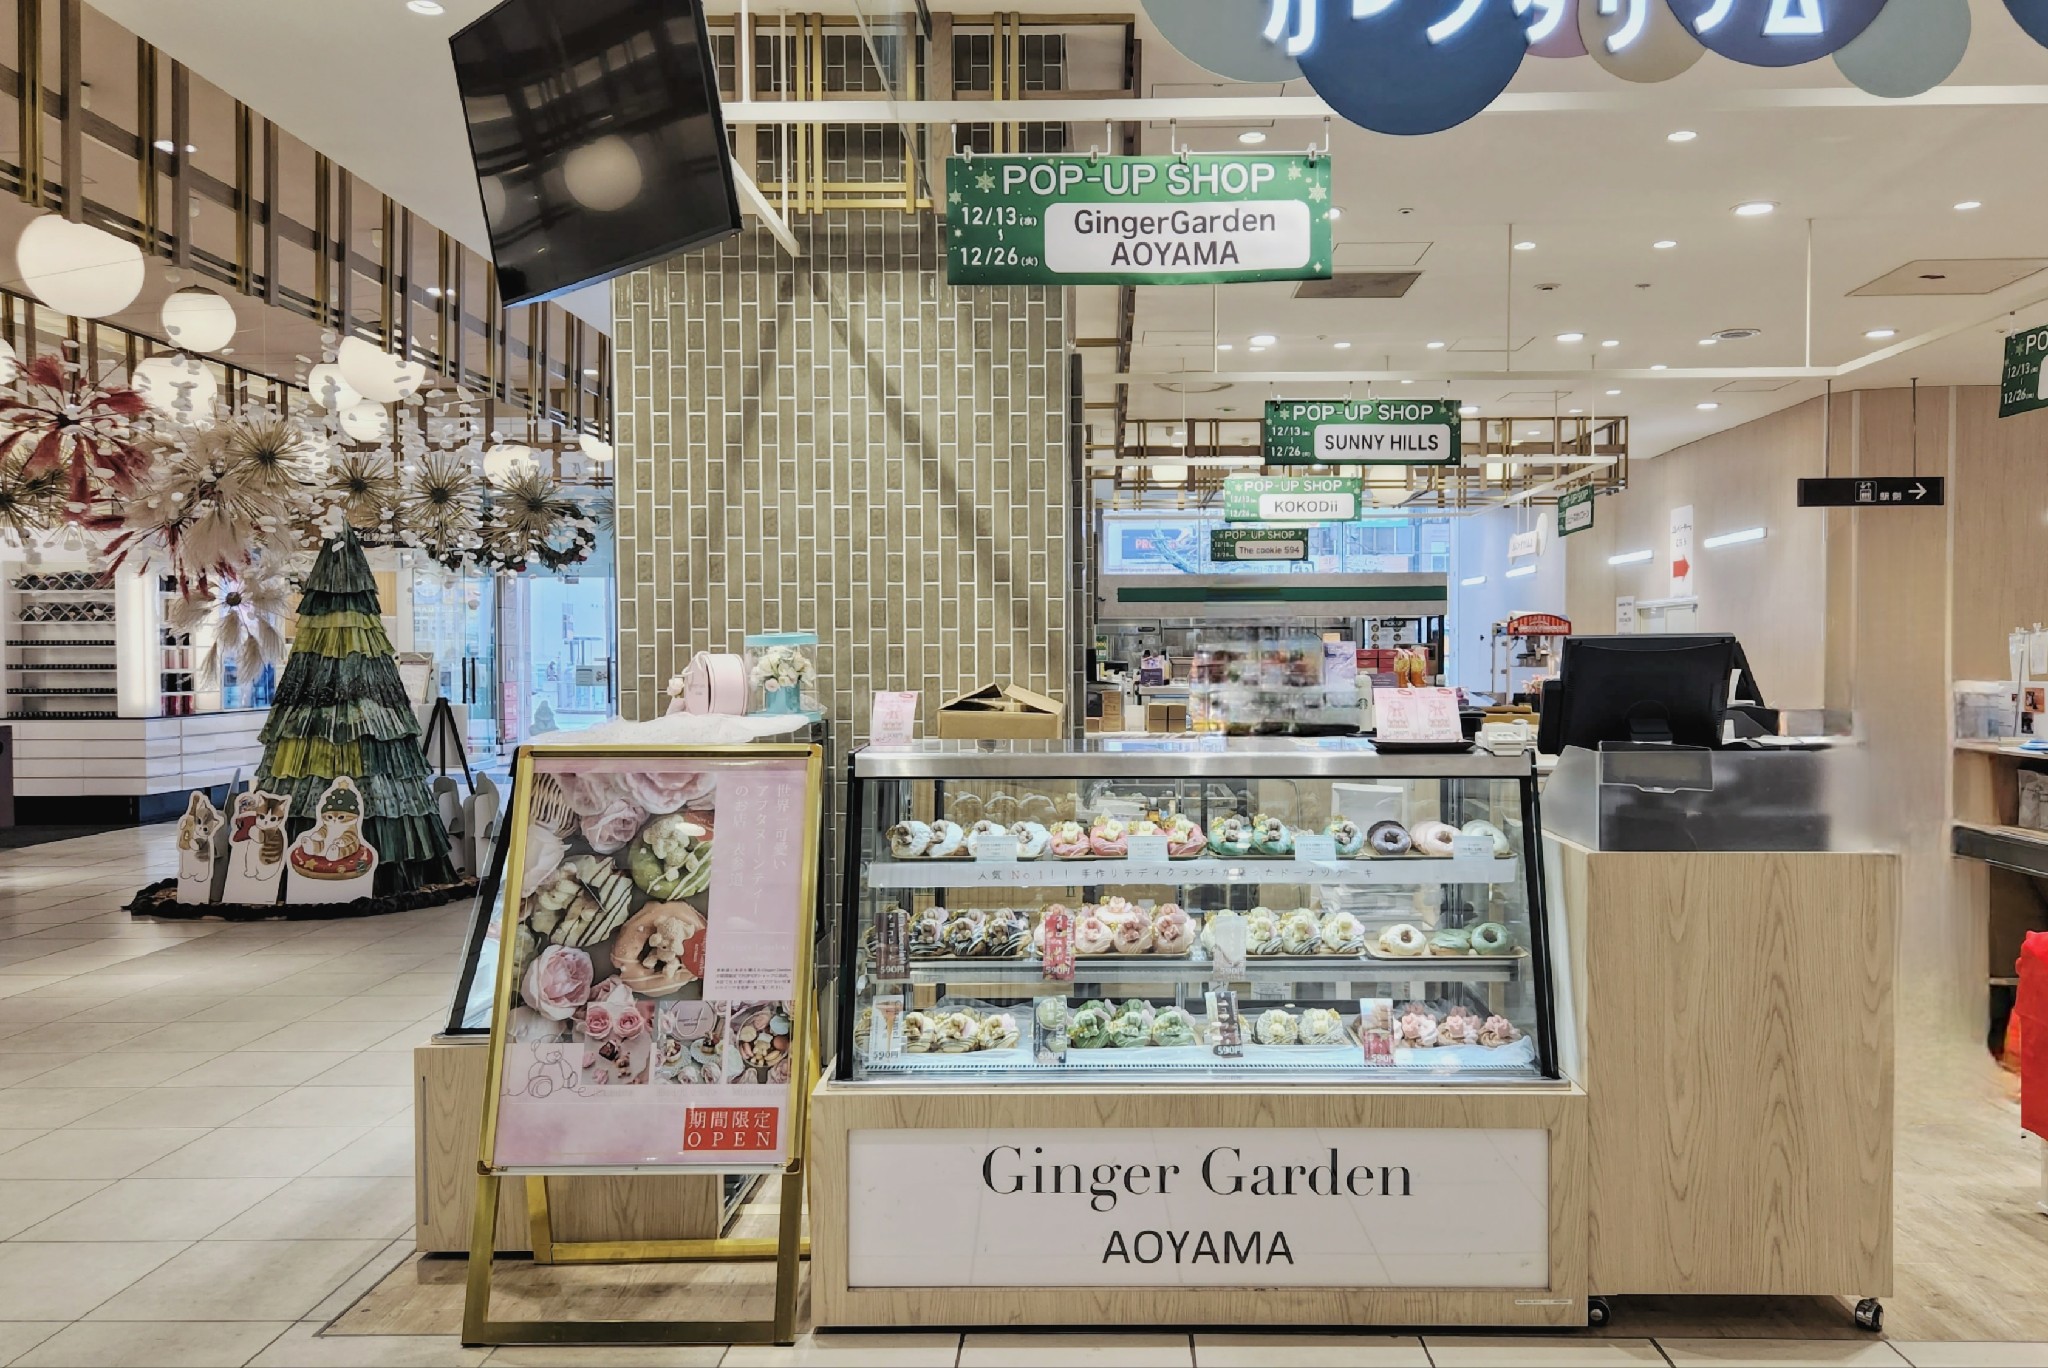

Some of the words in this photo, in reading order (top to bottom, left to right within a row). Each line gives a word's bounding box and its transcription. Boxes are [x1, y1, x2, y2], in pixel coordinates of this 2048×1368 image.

[1002, 163, 1158, 197] POP-UP
[1166, 162, 1276, 196] SHOP
[1074, 207, 1276, 239] GingerGarden
[1110, 240, 1240, 267] AOYAMA
[1292, 405, 1373, 423] POP-UP
[1377, 404, 1435, 421] SHOP
[1324, 434, 1384, 452] SUNNY
[1390, 433, 1439, 452] HILLS
[1244, 479, 1300, 492] POP-UP
[1303, 478, 1343, 492] SHOP
[1267, 530, 1296, 540] SHOP
[1239, 546, 1254, 555] The
[880, 965, 905, 975] 590円
[1045, 966, 1070, 975] 590円
[688, 1110, 771, 1129] 期間限定
[687, 1131, 772, 1148] OPEN
[981, 1145, 1181, 1213] Ginger
[1200, 1145, 1414, 1197] Garden
[1102, 1230, 1295, 1266] AOYAMA
